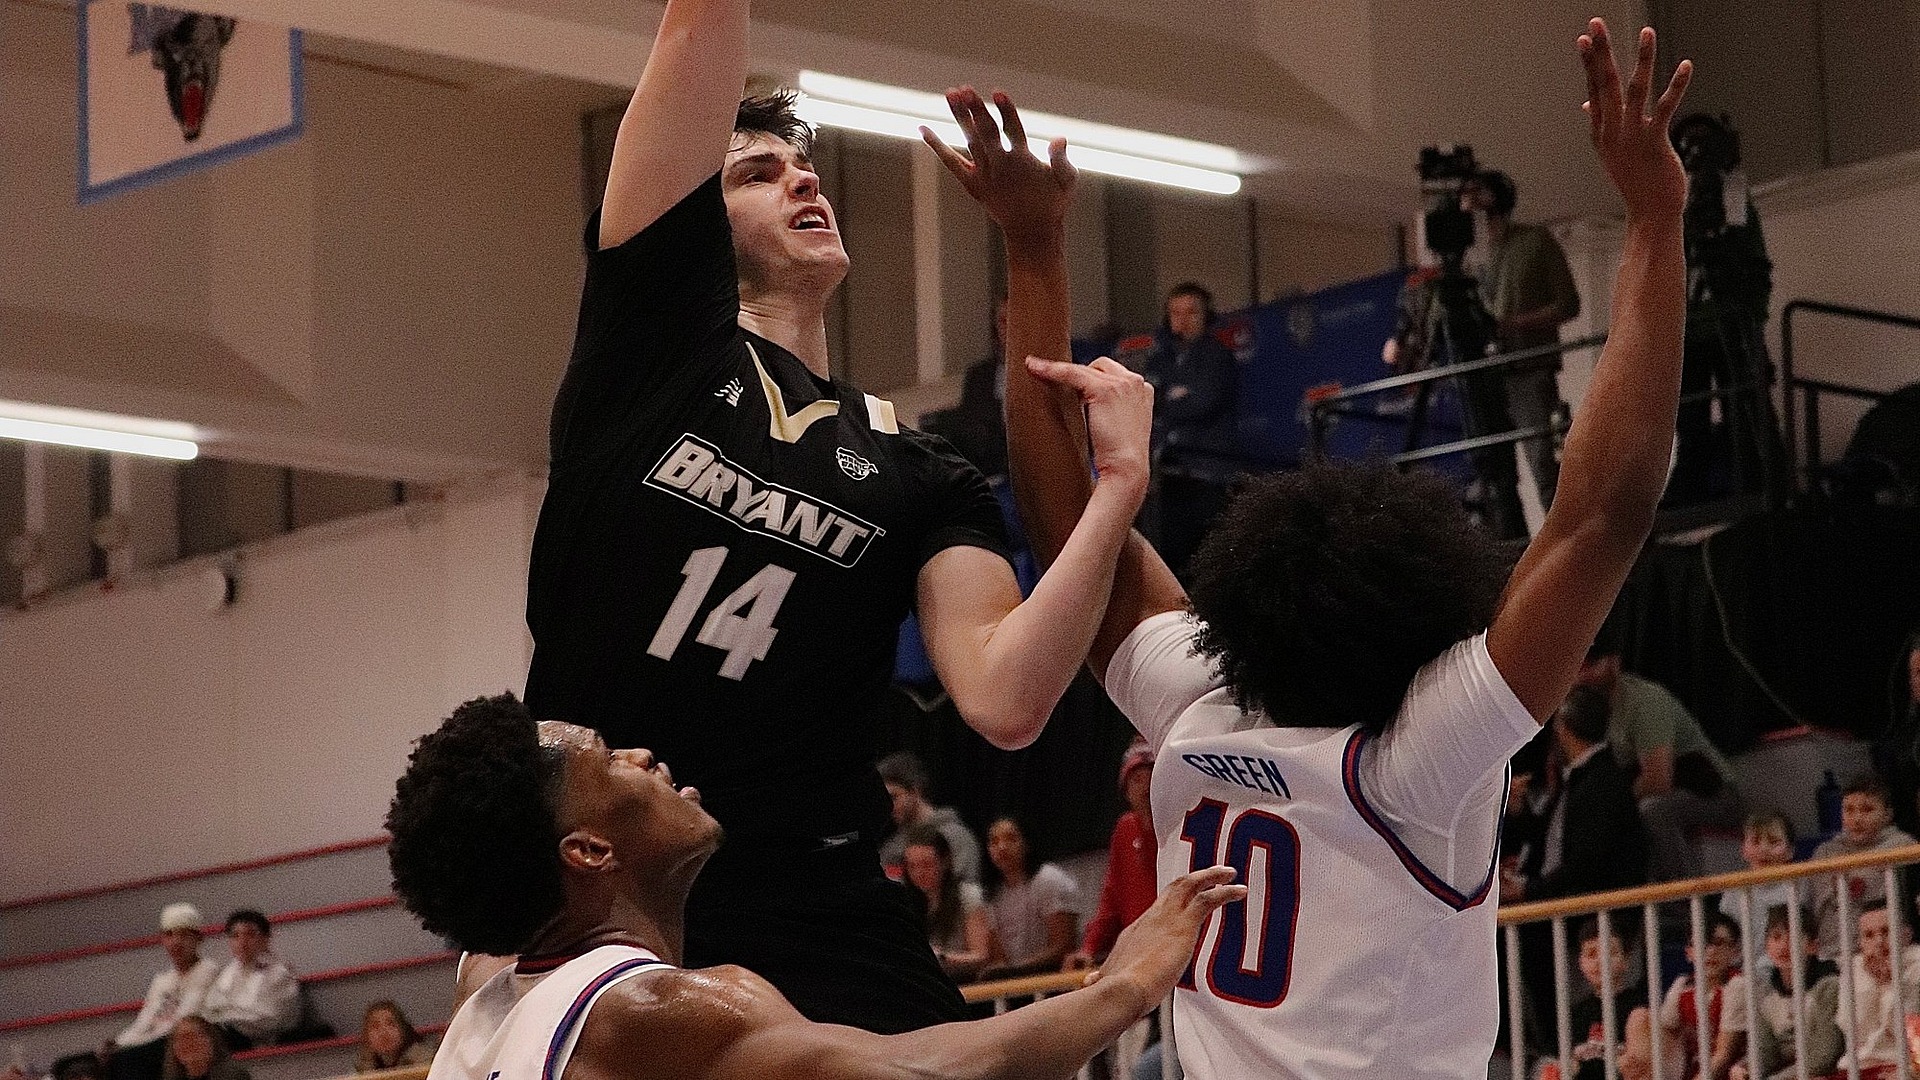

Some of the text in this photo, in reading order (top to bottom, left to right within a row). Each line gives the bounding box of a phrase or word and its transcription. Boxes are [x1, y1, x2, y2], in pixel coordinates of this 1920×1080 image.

[653, 440, 870, 558] BRYANT
[646, 546, 797, 681] 14
[1181, 754, 1291, 800] GREEN
[1176, 796, 1301, 1008] 10
